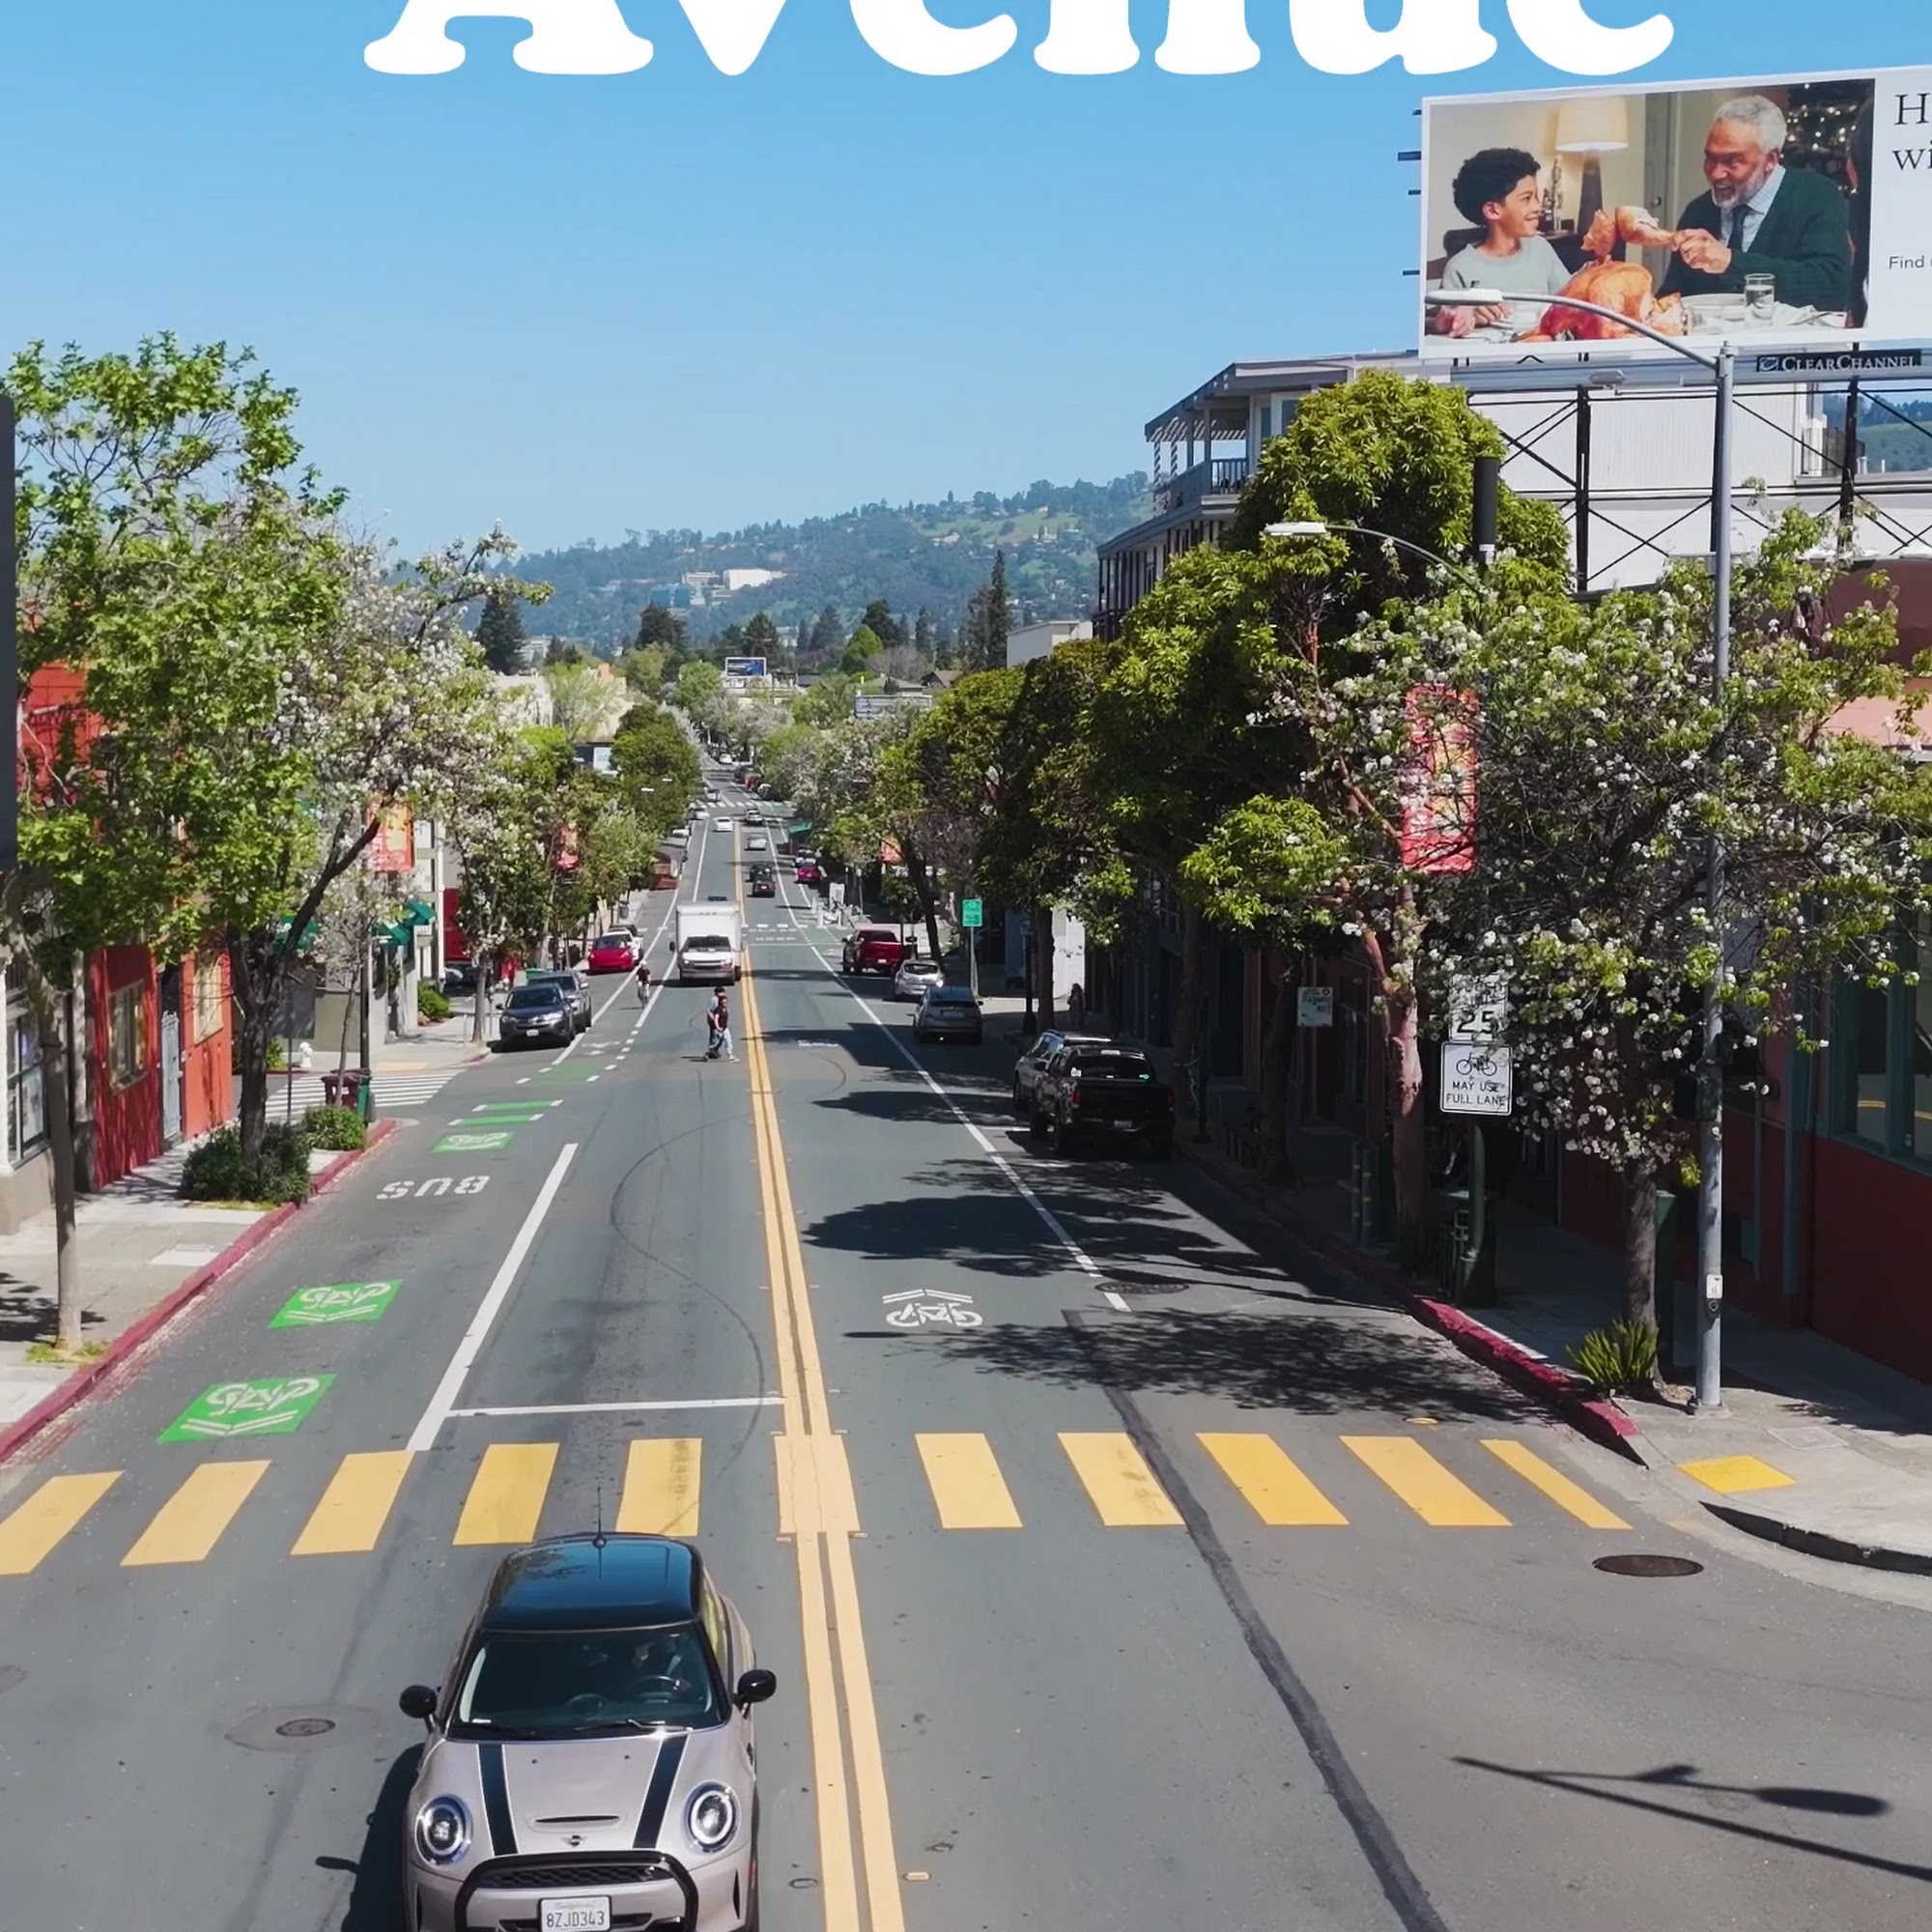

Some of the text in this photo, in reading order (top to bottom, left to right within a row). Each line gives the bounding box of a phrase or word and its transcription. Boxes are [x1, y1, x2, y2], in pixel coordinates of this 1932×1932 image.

[1889, 255, 1924, 270] Find
[1457, 1009, 1499, 1035] 25
[1452, 1081, 1474, 1091] MAY
[1446, 1093, 1507, 1107] FULL LANE
[376, 1176, 491, 1200] BUS
[546, 1911, 605, 1928] 8ZJD343
